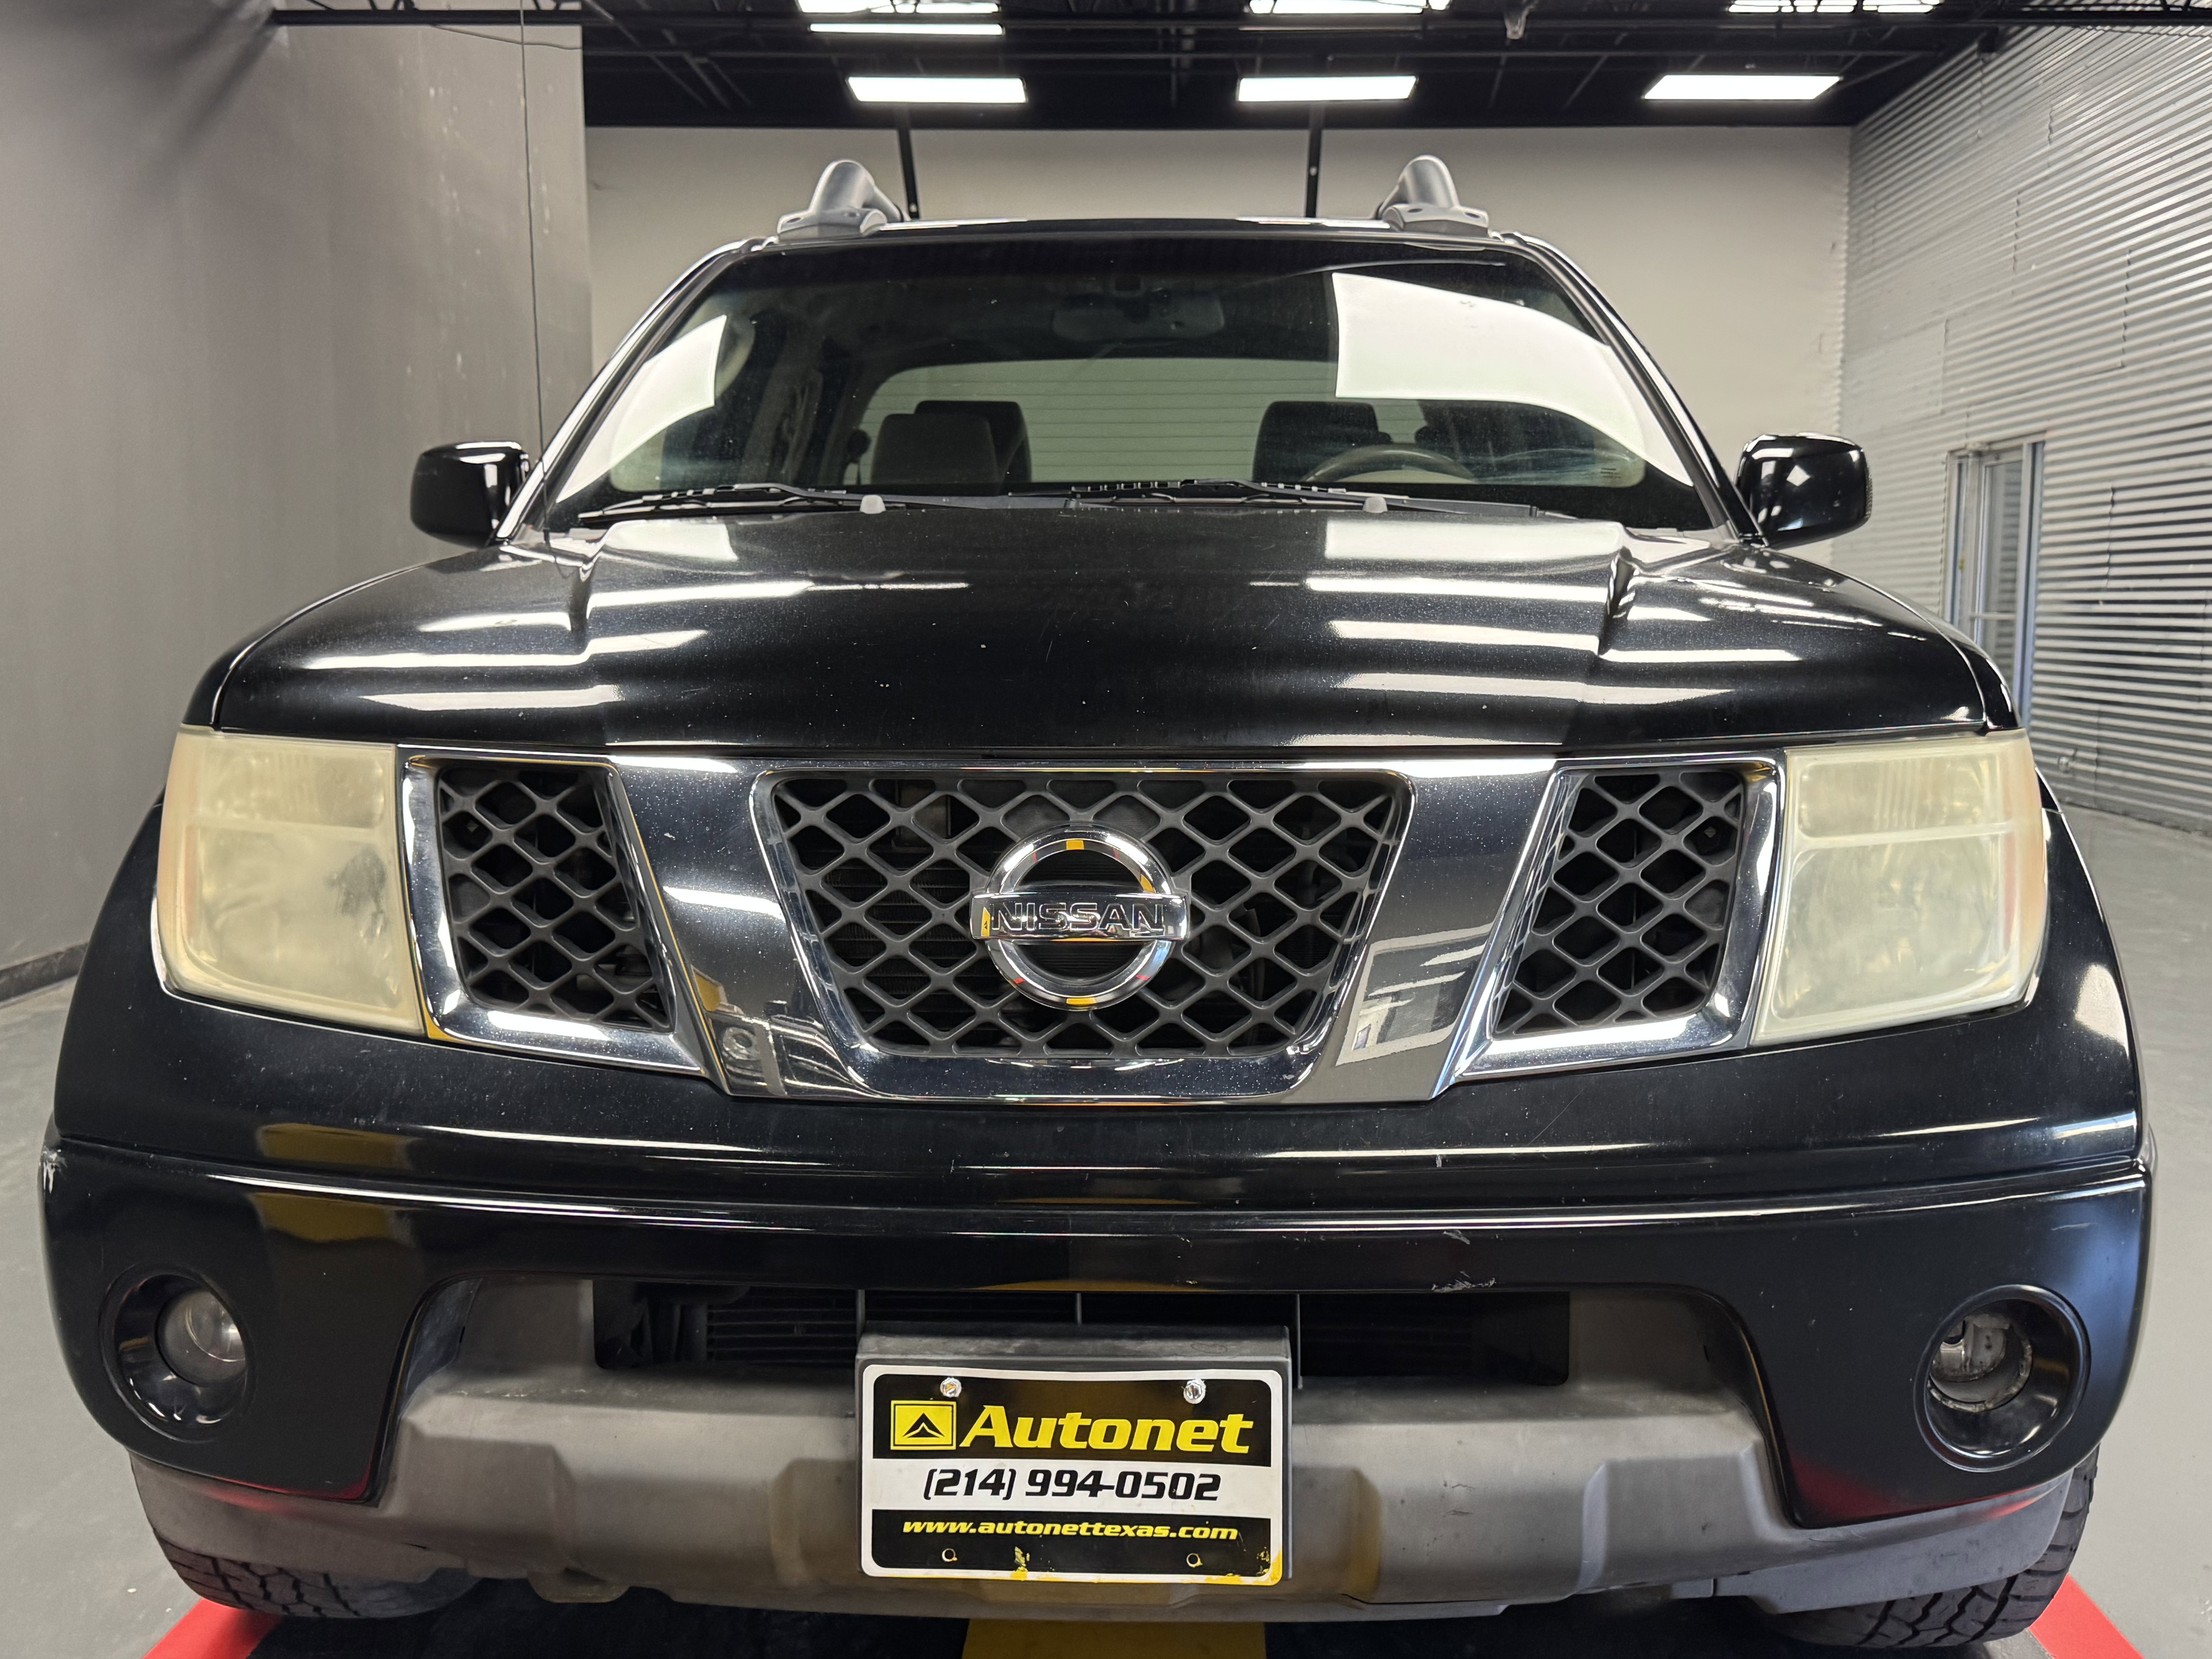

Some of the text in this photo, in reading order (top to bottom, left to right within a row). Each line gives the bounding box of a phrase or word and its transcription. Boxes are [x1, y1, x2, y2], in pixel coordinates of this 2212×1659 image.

[991, 903, 1165, 931] NISSAN
[959, 1405, 1254, 1453] Autonet
[924, 1469, 1221, 1501] (214) 994-0502
[903, 1521, 1238, 1540] www.autonettexas.com
